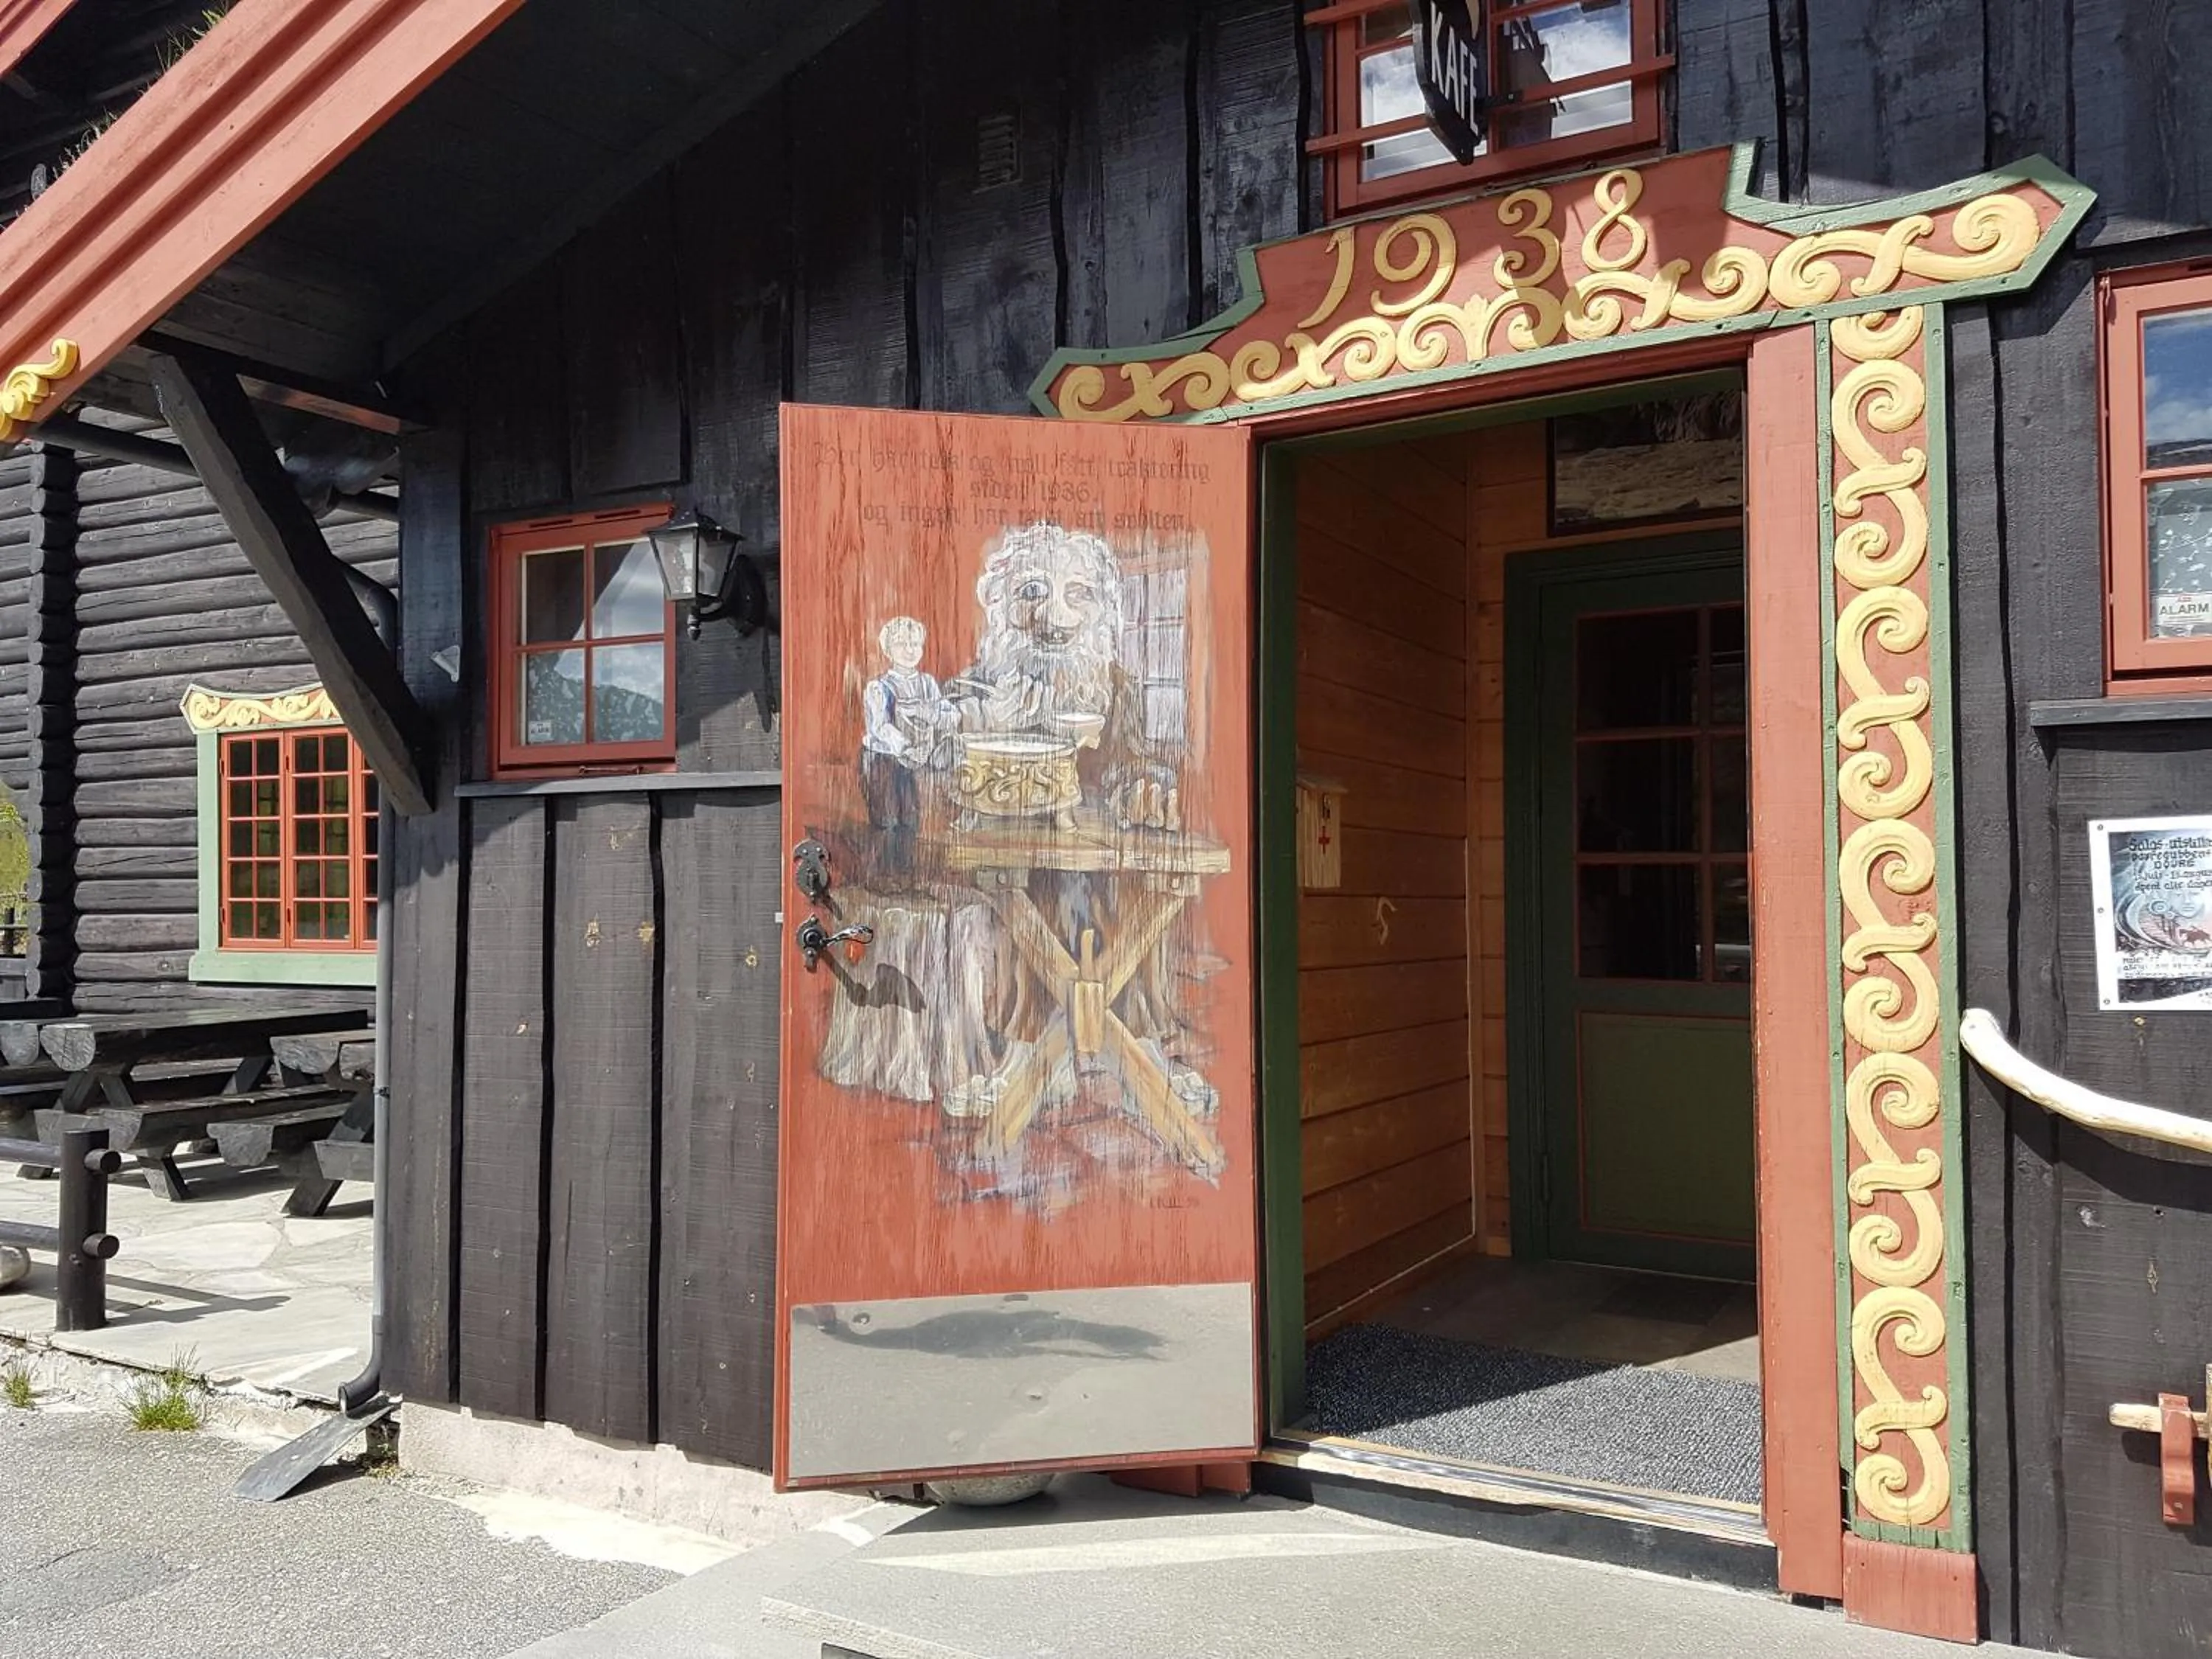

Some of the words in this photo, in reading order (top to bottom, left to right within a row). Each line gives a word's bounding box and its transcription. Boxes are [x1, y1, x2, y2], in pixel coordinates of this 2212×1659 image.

[1430, 1, 1478, 136] KAFE
[1296, 168, 1647, 329] 1938
[970, 454, 995, 477] og
[863, 504, 889, 529] og
[2159, 602, 2209, 615] ALARM
